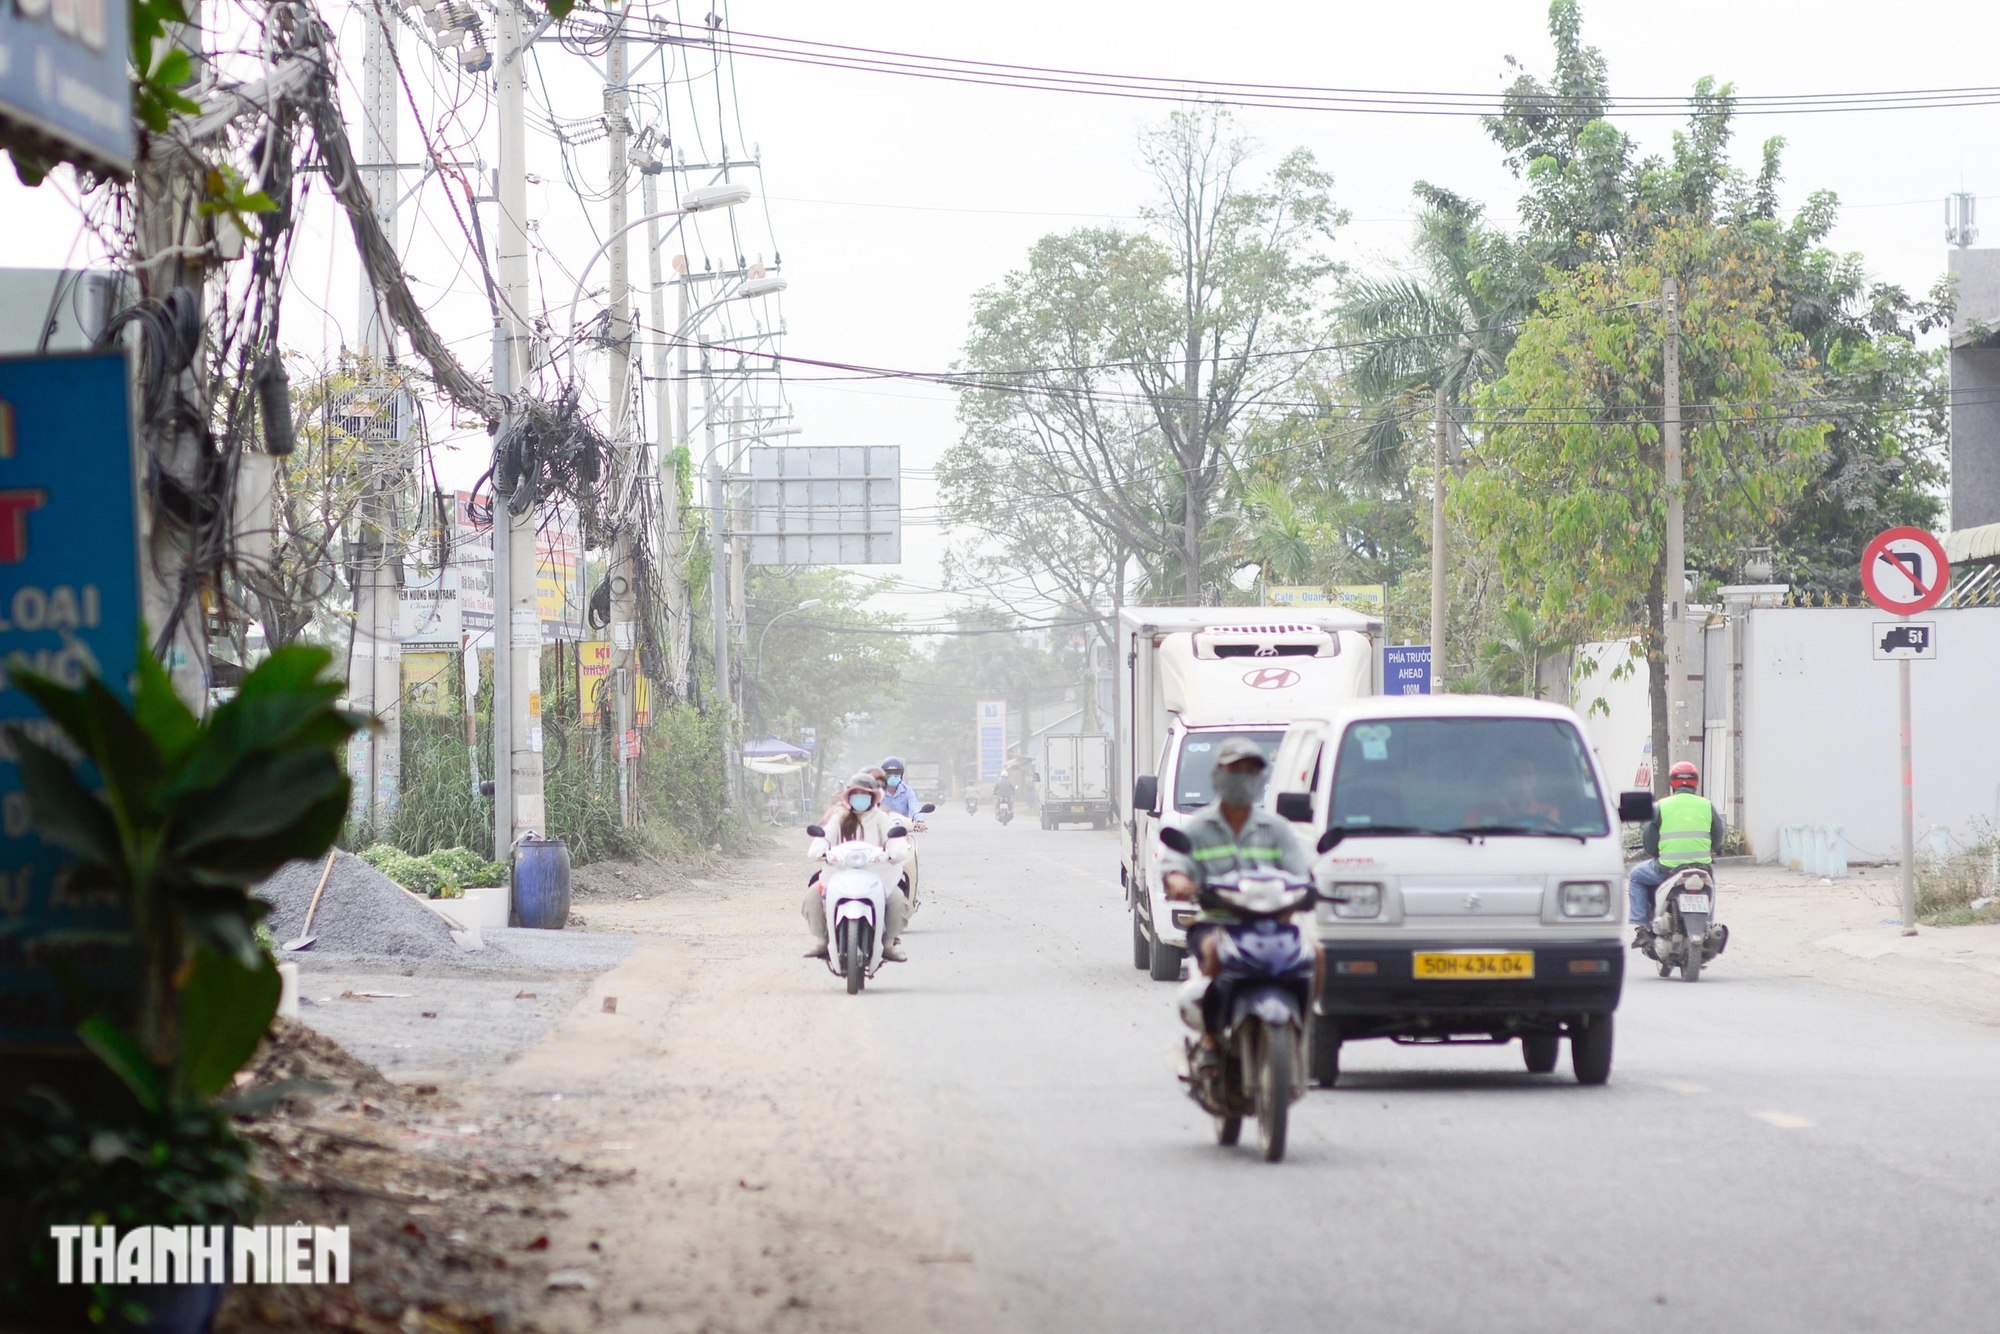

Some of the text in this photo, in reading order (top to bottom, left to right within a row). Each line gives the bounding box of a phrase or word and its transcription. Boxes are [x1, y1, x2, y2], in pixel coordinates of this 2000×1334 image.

[1908, 629, 1923, 644] 5t
[1388, 650, 1405, 663] PHÍA
[1398, 668, 1424, 679] AHEAD
[1402, 683, 1420, 695] 100M
[1425, 957, 1523, 975] 50H-434.04
